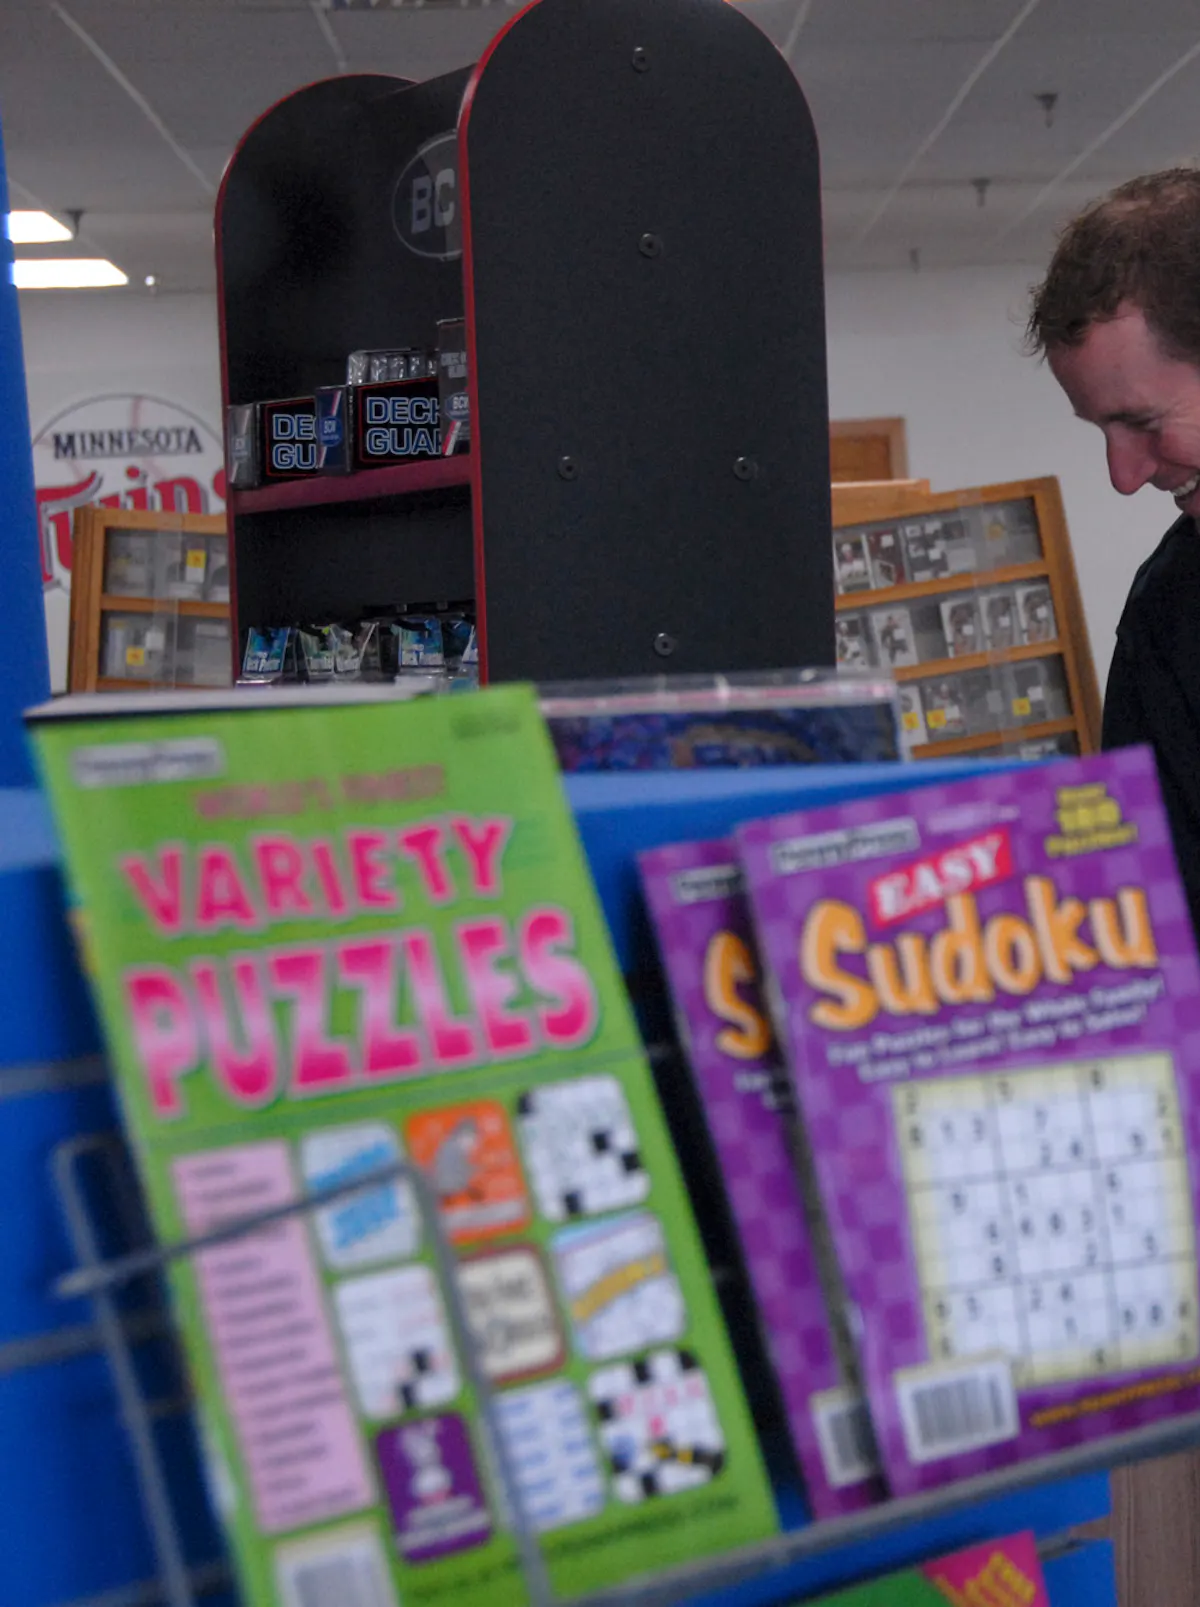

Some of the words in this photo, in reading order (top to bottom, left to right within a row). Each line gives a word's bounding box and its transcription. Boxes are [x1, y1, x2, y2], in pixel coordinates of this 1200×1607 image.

[411, 168, 455, 234] BC
[52, 426, 203, 460] MINNESOTA
[272, 414, 316, 440] DE
[272, 443, 318, 469] GU
[117, 816, 511, 934] VARIETY
[873, 832, 1004, 920] EASY
[703, 930, 770, 1060] S
[802, 875, 1158, 1030] Sudoku
[123, 907, 598, 1118] PUZZLES
